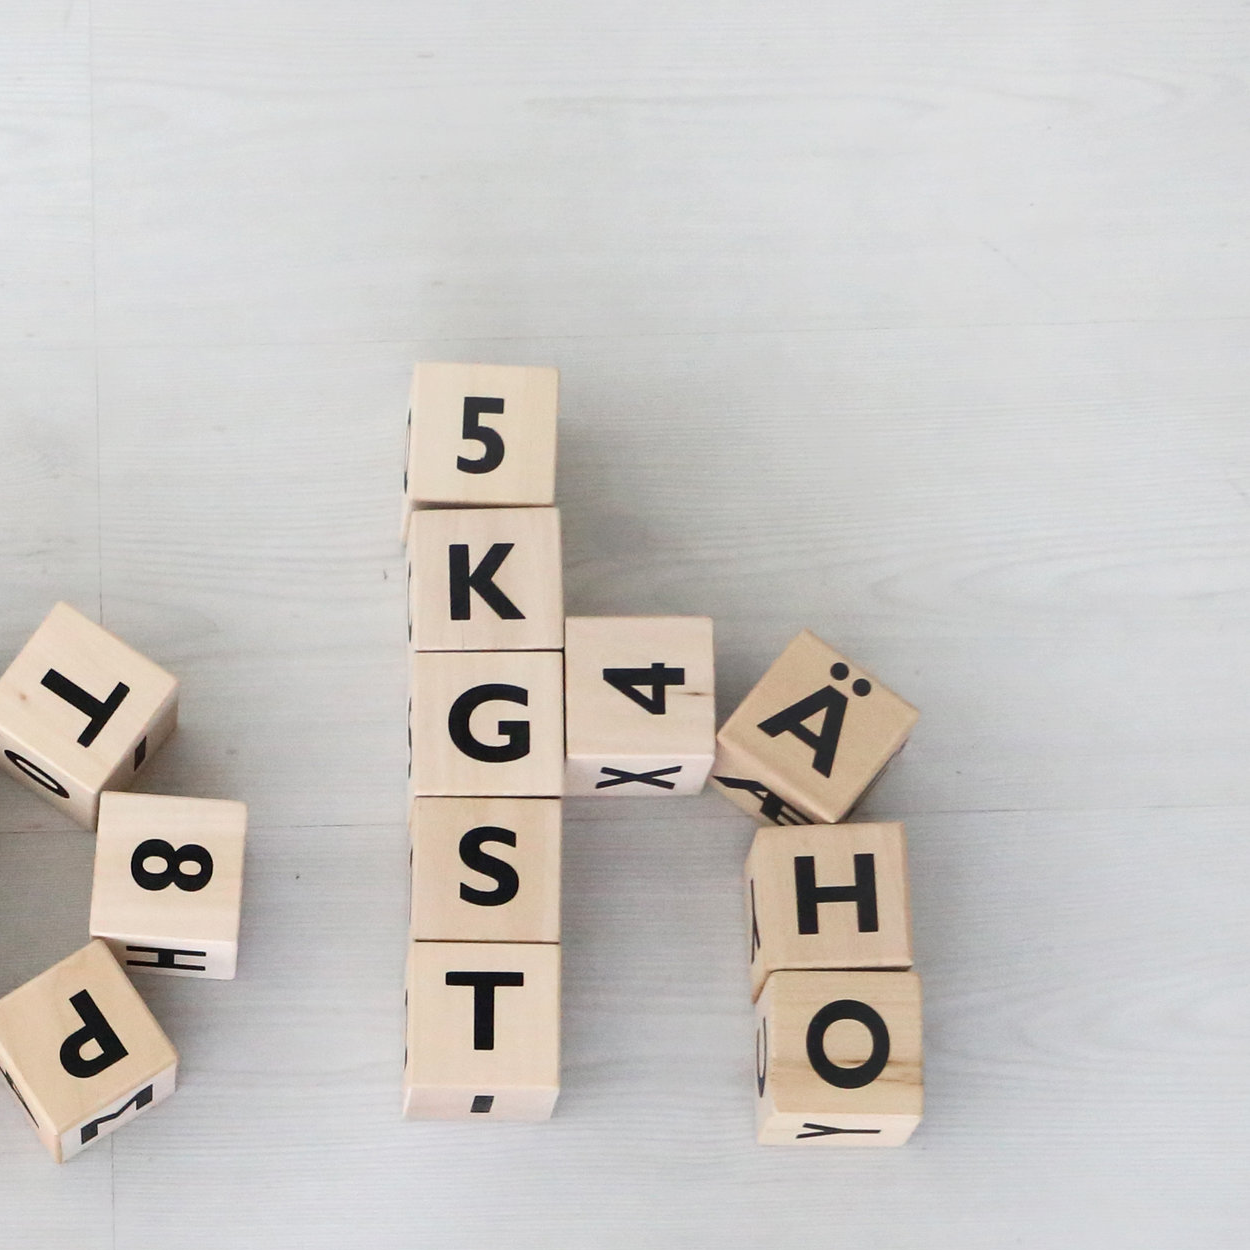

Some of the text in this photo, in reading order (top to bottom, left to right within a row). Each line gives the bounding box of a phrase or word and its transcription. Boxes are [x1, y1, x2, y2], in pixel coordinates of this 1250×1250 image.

[457, 397, 504, 474] 5
[449, 543, 525, 620] K
[41, 669, 130, 747] T
[448, 684, 530, 762] G
[603, 663, 684, 714] 4
[757, 663, 871, 778] Ä
[131, 839, 213, 892] 8
[459, 827, 519, 906] S
[795, 854, 878, 935] H
[60, 989, 128, 1078] P
[446, 972, 523, 1050] T
[806, 1000, 890, 1089] O
